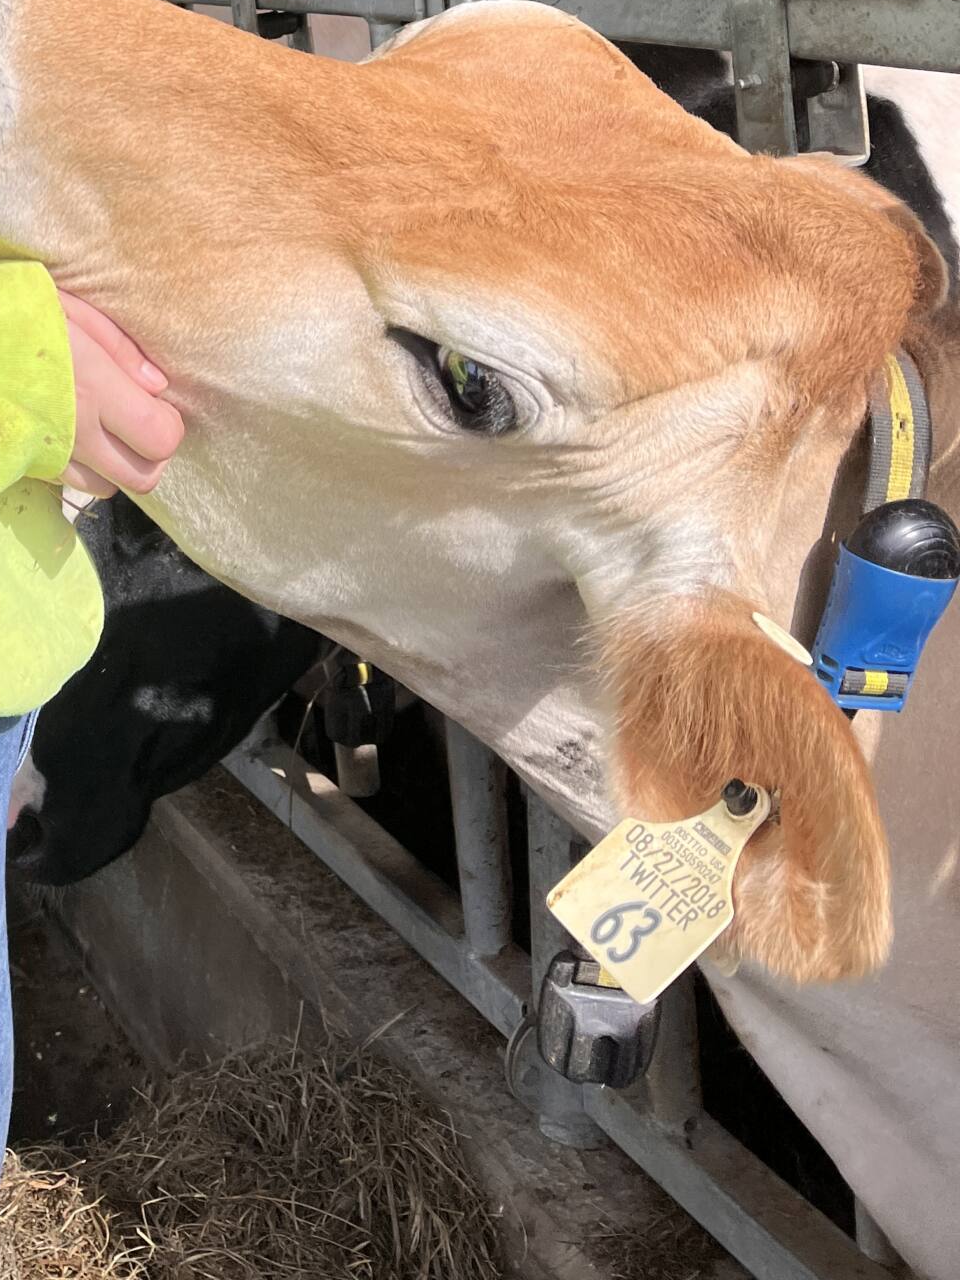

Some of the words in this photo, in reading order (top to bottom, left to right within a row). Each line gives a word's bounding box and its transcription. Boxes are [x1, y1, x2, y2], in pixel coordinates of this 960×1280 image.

[620, 849, 699, 932] TWITTER
[626, 824, 727, 919] 08/27/2018
[709, 856, 726, 874] USA
[591, 901, 662, 963] 63
